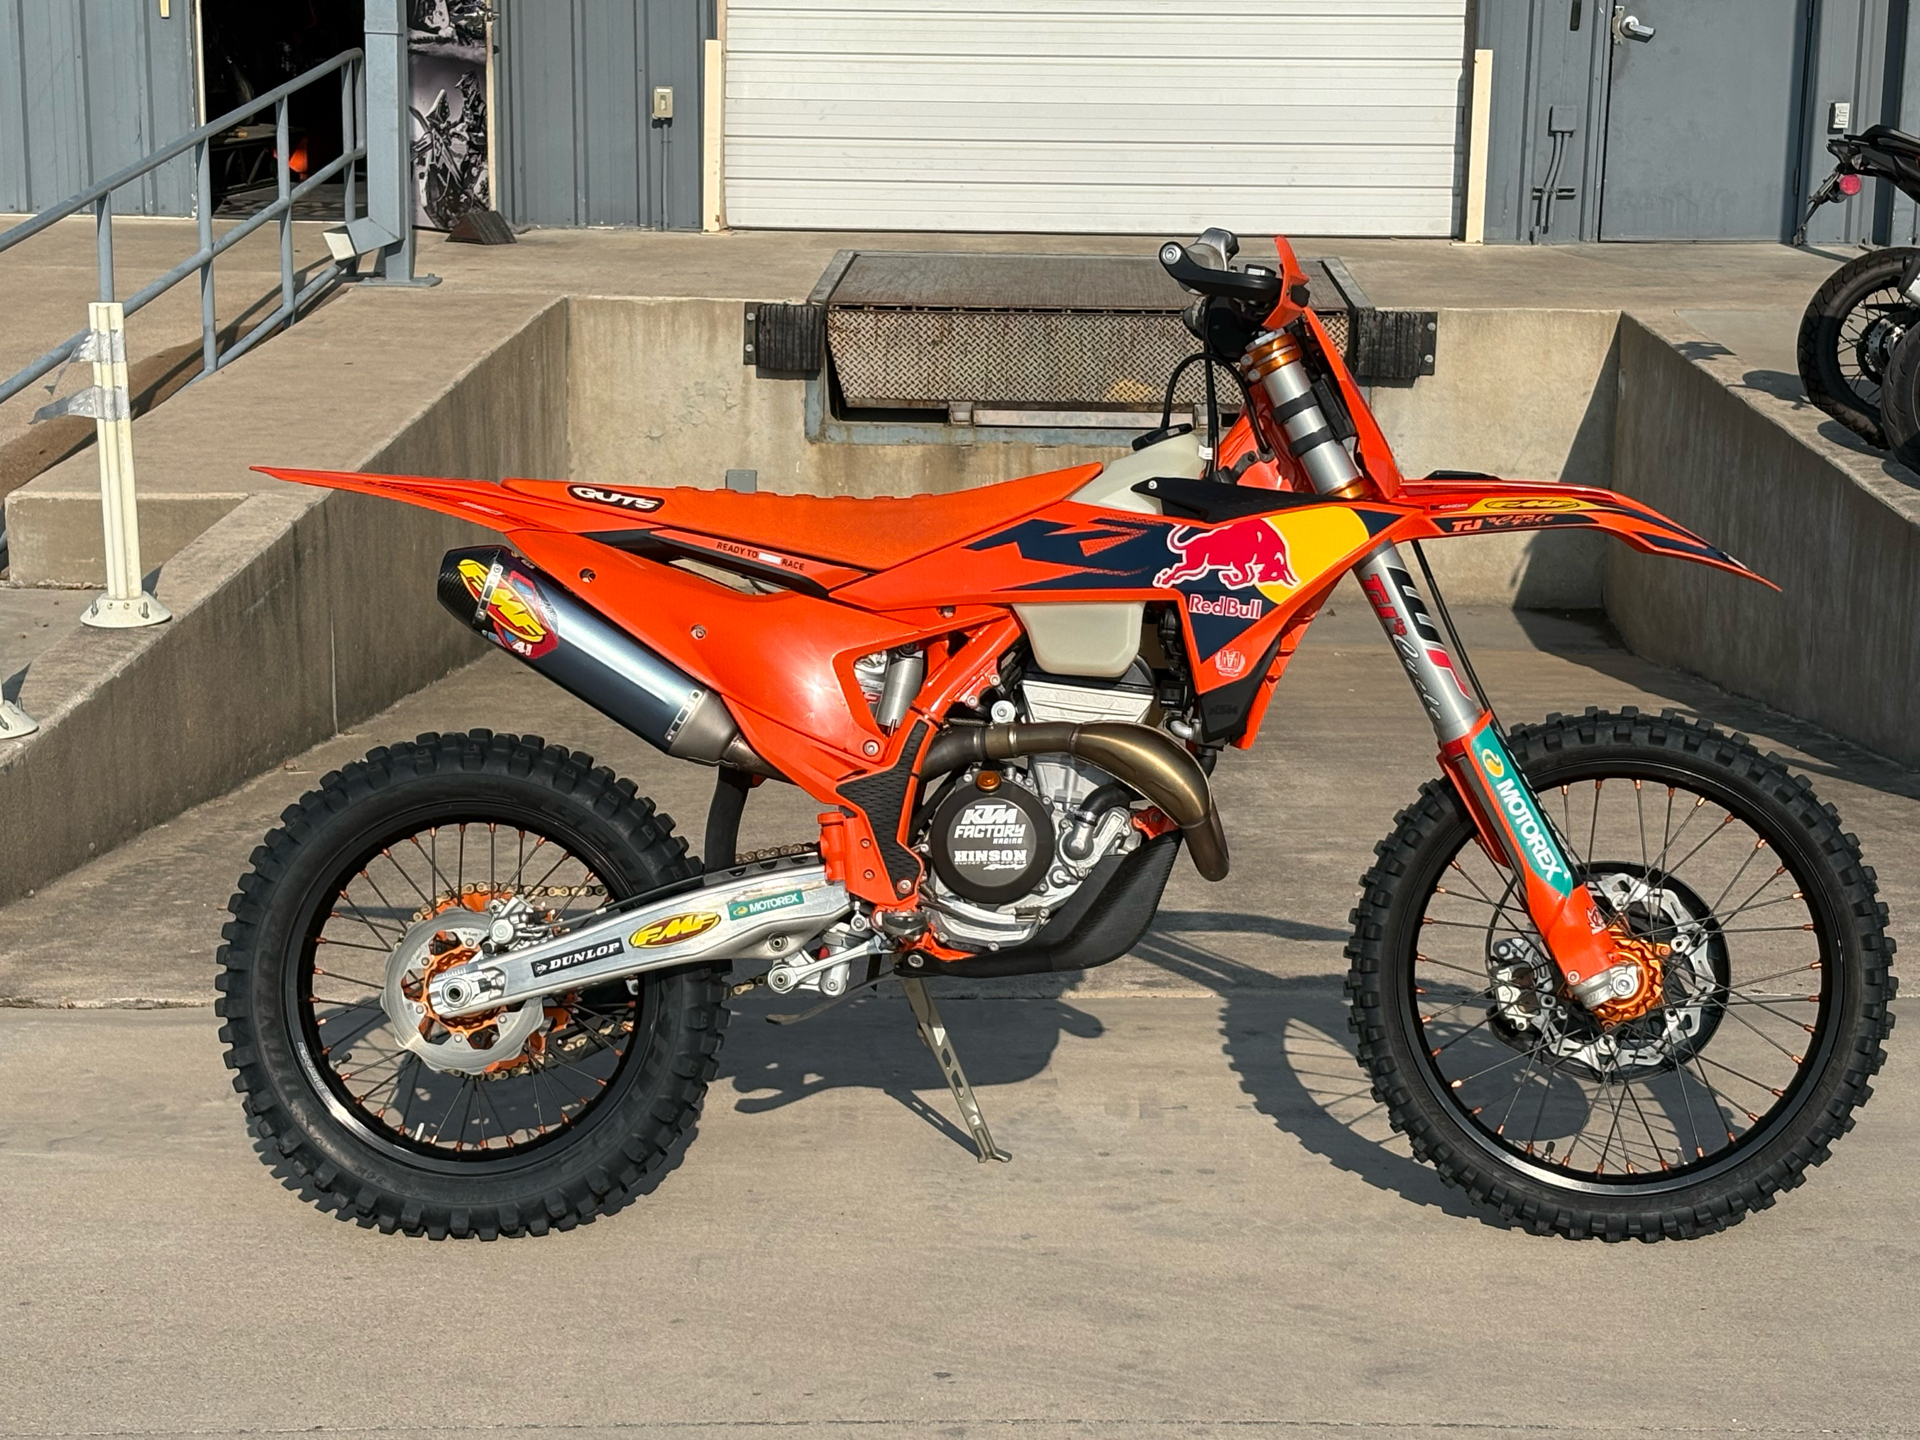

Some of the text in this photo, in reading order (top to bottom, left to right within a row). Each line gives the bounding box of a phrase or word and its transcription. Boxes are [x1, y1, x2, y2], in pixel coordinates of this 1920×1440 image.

[572, 487, 658, 510] GUTS
[716, 541, 805, 570] READY TO RACE
[960, 804, 1018, 825] KTM
[954, 824, 1026, 839] FACTORY
[1496, 778, 1563, 881] MOTOREX
[954, 849, 1028, 862] HINSON
[748, 893, 800, 912] MOTOREX
[633, 912, 717, 946] FMF
[549, 942, 620, 970] DUNLOP
